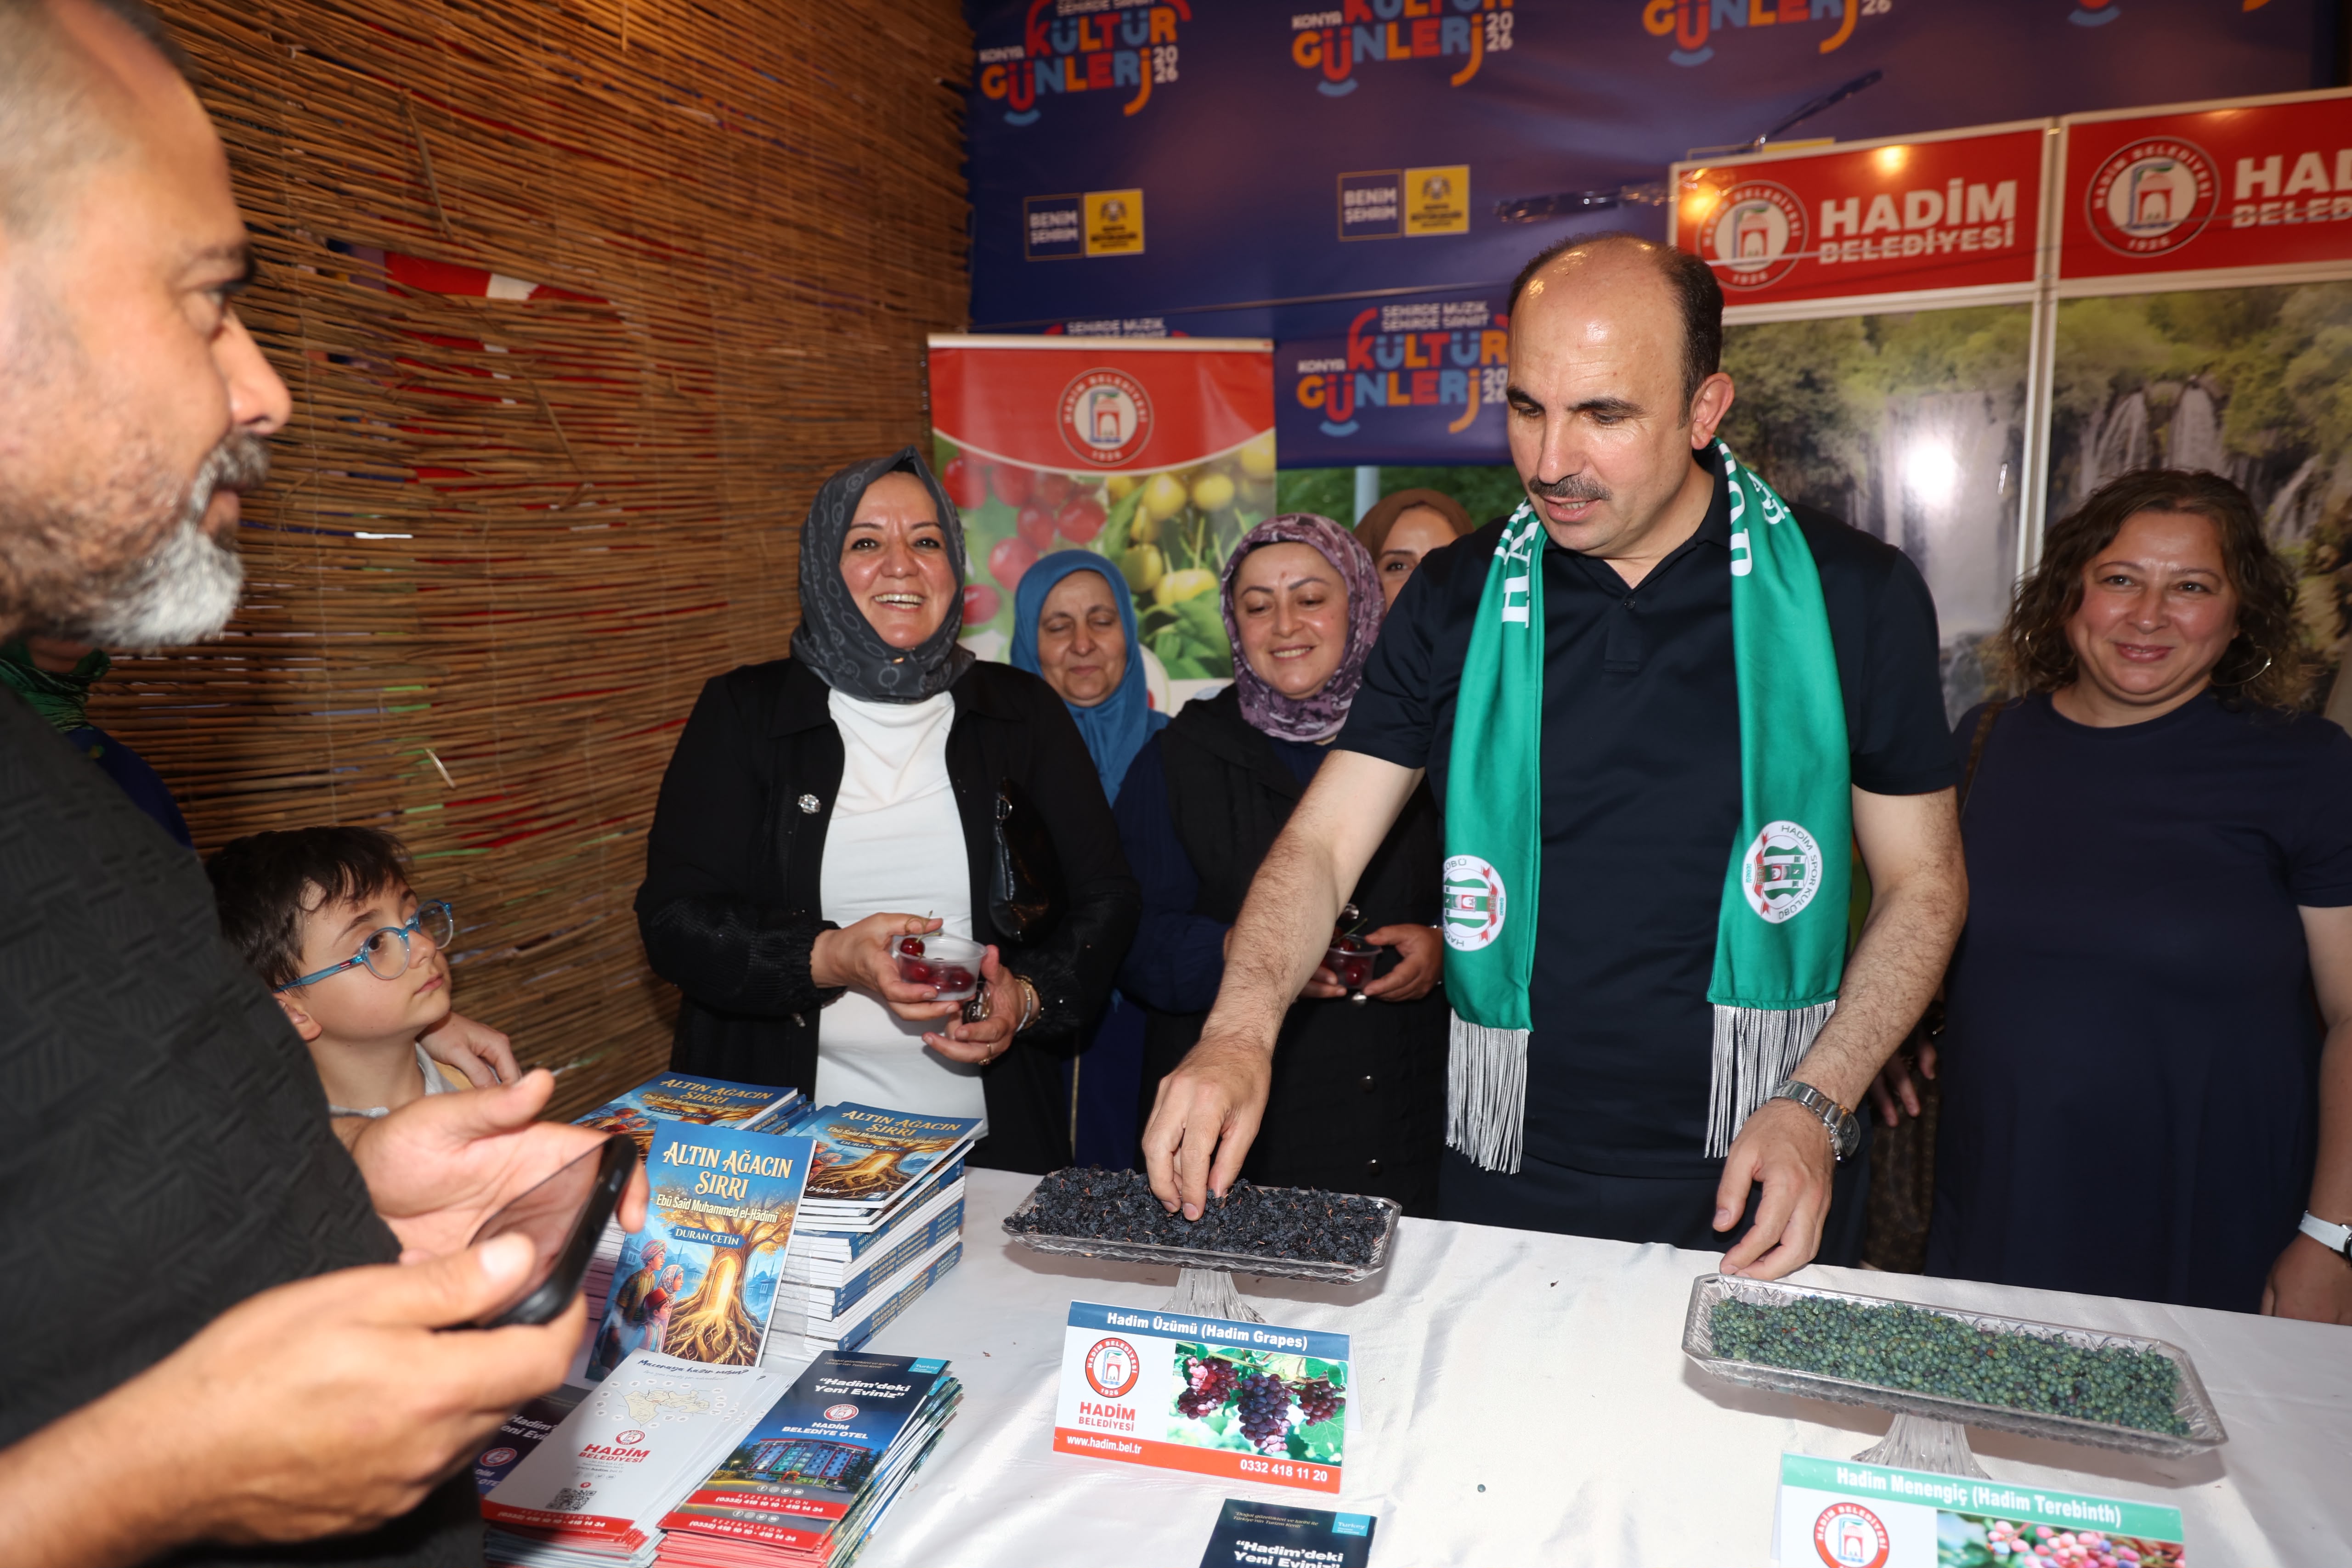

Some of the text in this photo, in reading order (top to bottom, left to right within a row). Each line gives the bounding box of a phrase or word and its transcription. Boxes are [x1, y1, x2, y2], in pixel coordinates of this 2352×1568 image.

[1292, 11, 1342, 29] KONYA
[1486, 11, 1513, 31] 20
[1025, 4, 1177, 57] KÜLTÜR
[1486, 30, 1513, 52] 26
[1820, 178, 2018, 238] HADİM
[1819, 220, 2015, 265] BELEDİYESİ
[1347, 316, 1508, 370] KÜLTÜR
[1781, 825, 1814, 851] HADİM
[1808, 854, 1818, 886] SPOR
[660, 1079, 774, 1100] ALTIN AĞACIN
[680, 1091, 730, 1104] SIRRI
[650, 1106, 682, 1116] DURAN
[841, 1110, 962, 1131] ALTIN AĞACIN
[859, 1131, 905, 1143] Muhammed
[865, 1123, 918, 1137] SIRRI
[840, 1140, 873, 1150] DURAN
[662, 1141, 794, 1179] ALTIN AĞACIN
[695, 1171, 750, 1201] SIRRI
[656, 1194, 779, 1224] Ebû Saîd Muhammed el-Hâdimî
[675, 1228, 740, 1246] DURAN ÇETİN
[1107, 1312, 1308, 1351] Hadim Üzümü (Hadim Grapes)
[638, 1359, 684, 1372] Maceraya
[1088, 1340, 1138, 1374] HADİM BELEDİYESİ
[815, 1385, 905, 1398] Yeni Eviniz"
[1080, 1401, 1136, 1421] HADİM
[500, 1424, 526, 1435] eni
[782, 1426, 838, 1436] BELEDİYE
[1079, 1416, 1135, 1432] BELEDİYESİ
[583, 1444, 650, 1458] HADİM
[1067, 1435, 1142, 1454] www.hadim.bel.tr
[577, 1452, 645, 1463] BELEDİYESİ
[1240, 1459, 1328, 1482] 0332 418 11 20
[737, 1494, 809, 1506] REZERVASYON
[1838, 1467, 2122, 1529] Hadim Menengiç (Hadim Terebinth)
[689, 1520, 716, 1529] (0332)
[712, 1518, 783, 1533] REZERVASYON
[1337, 1522, 1366, 1530] Turkey
[1816, 1506, 1888, 1549] HADİM BELEDİYESİ
[1234, 1551, 1273, 1565] Yeni
